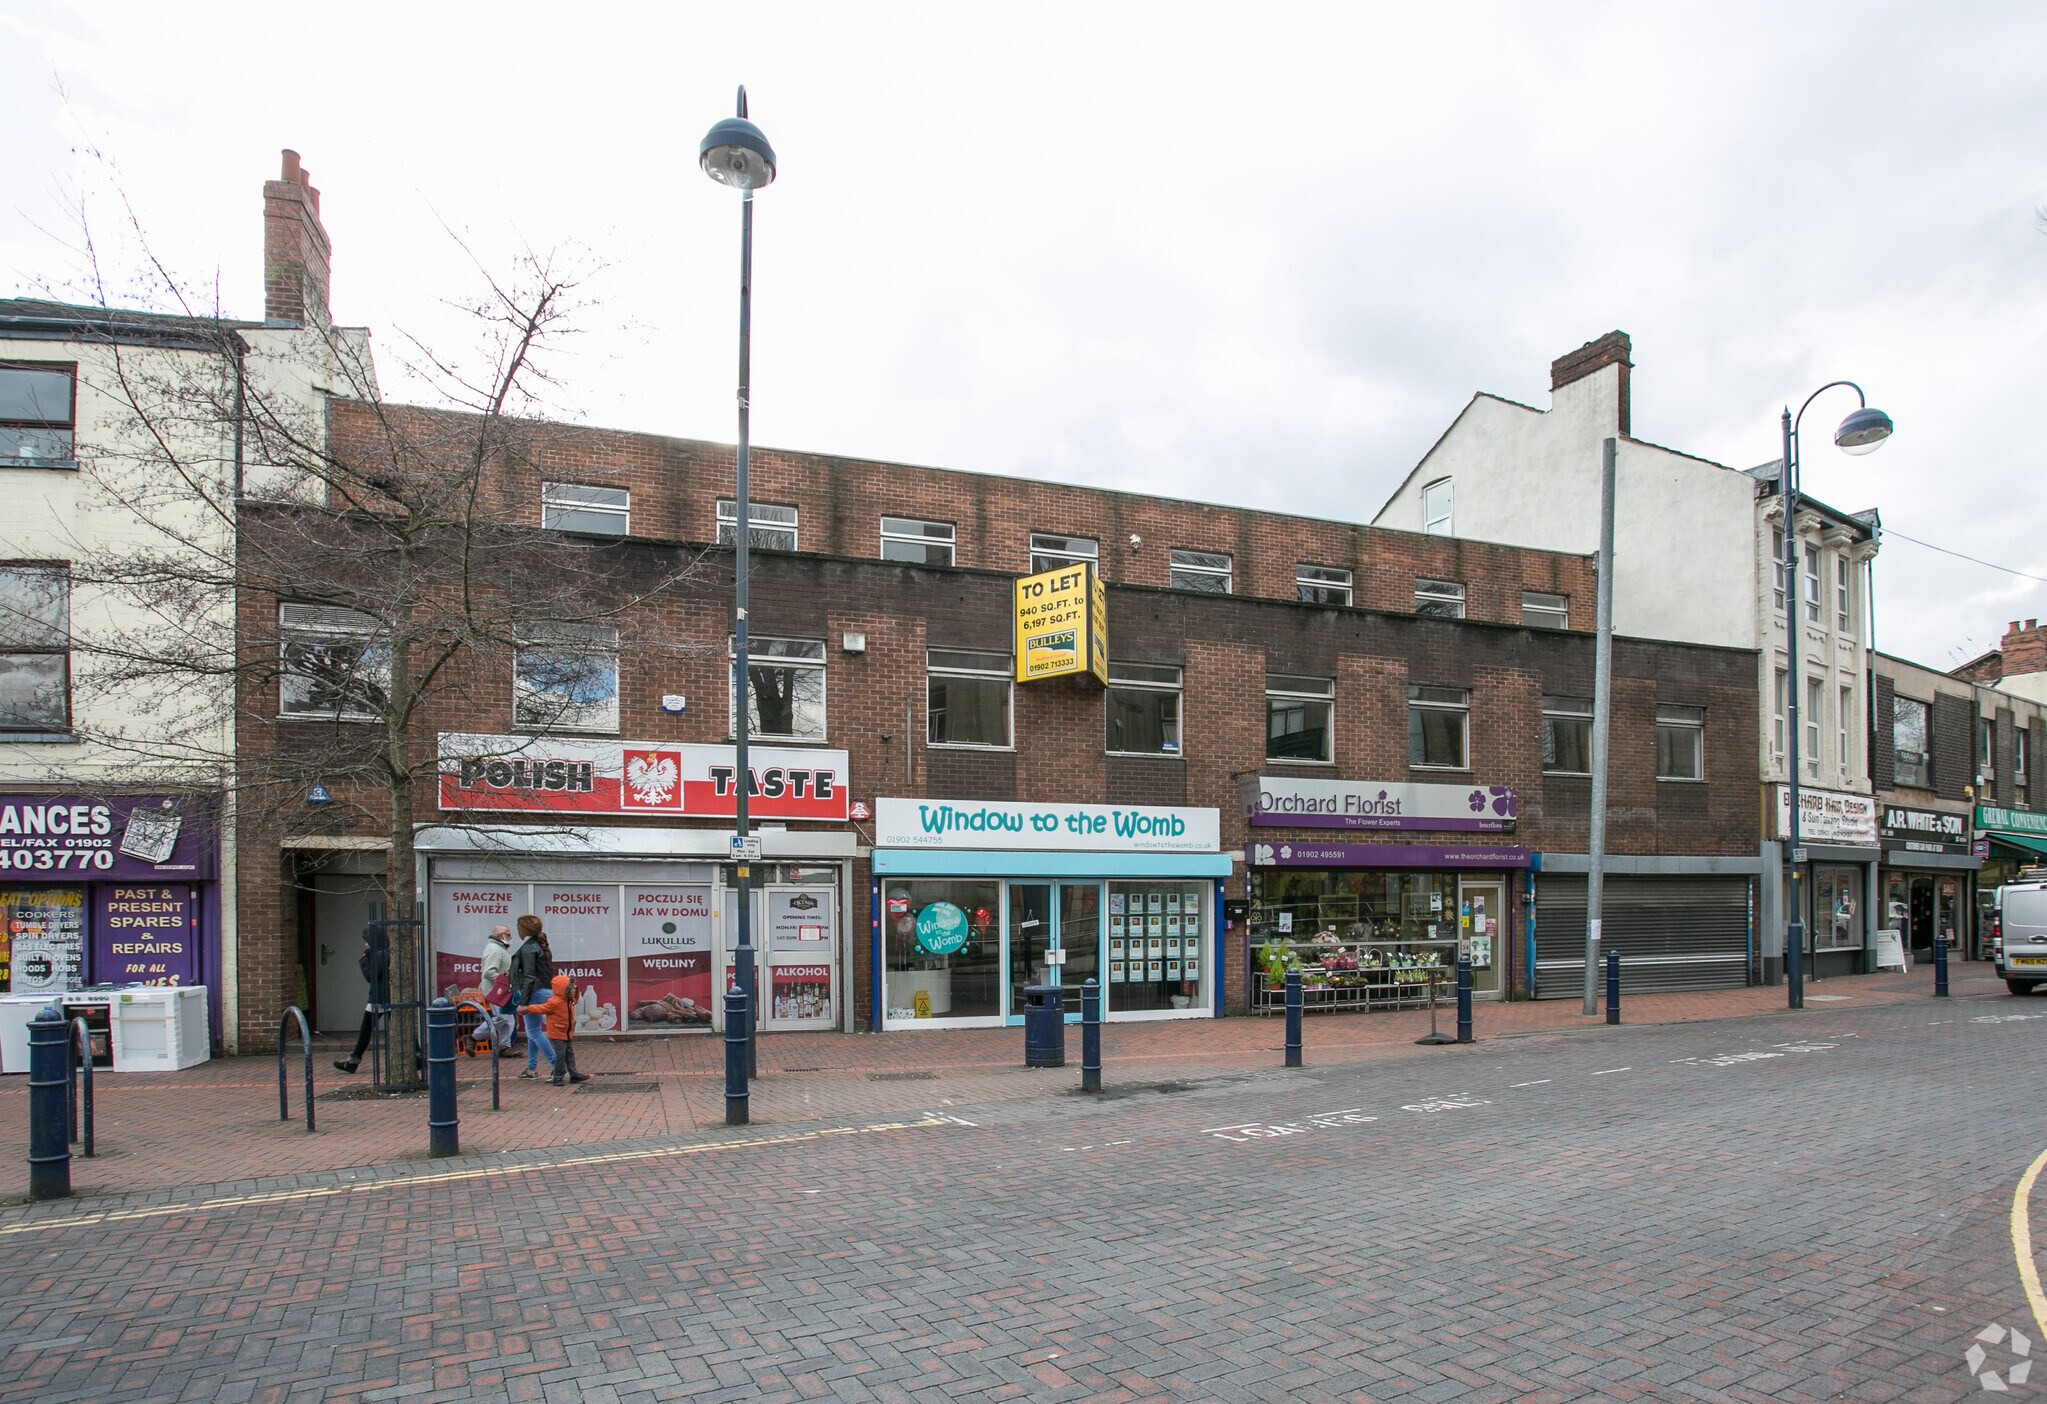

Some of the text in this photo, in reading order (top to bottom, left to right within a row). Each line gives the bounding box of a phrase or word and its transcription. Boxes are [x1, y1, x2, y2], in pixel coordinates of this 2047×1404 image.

[1022, 582, 1044, 599] TO
[1050, 572, 1082, 593] LET
[1020, 597, 1084, 617] 940 SQ.FT. to
[1023, 611, 1080, 630] 6,197 SQ.FT.
[1029, 632, 1074, 649] BULLEYS
[1029, 658, 1074, 672] 01902 713333
[459, 757, 594, 792] POLISH
[709, 765, 835, 799] TASTE
[1260, 790, 1402, 815] Orchard Florist
[0, 805, 112, 835] ANCES
[918, 805, 1185, 838] Window to the Womb
[1357, 818, 1377, 826] Flower
[1378, 819, 1401, 827] Experts
[1907, 811, 1937, 832] WHITE
[1942, 815, 1963, 834] SON
[65, 839, 112, 847] 01902
[887, 836, 943, 844] 01902 544755
[0, 849, 114, 870] 403770
[28, 893, 82, 907] OPTIONS
[115, 889, 173, 900] PAST &
[453, 892, 513, 903] SMACZNE
[553, 893, 602, 903] POLSKIE
[638, 894, 703, 906] POCZUJ SIĘ
[108, 902, 184, 912] PRESENT
[457, 903, 509, 915] I ŚWIEŻE
[544, 905, 610, 915] PRODUKTY
[631, 907, 709, 917] JAK W DOMU
[16, 911, 76, 919] COOKERS
[15, 921, 80, 929] TUMBLE DRYERS
[110, 916, 183, 928] SPARES
[917, 916, 961, 935] Window
[15, 932, 38, 940] SPIN
[41, 932, 80, 940] DRYERS
[140, 932, 155, 940] &
[641, 937, 696, 946] LUKULLUS
[928, 933, 963, 950] Womb
[15, 943, 33, 951] GAS
[112, 942, 183, 954] REPAIRS
[125, 963, 166, 973] FOR ALL
[643, 959, 696, 970] WĘDLINY
[558, 967, 604, 978] NABIAŁ
[776, 967, 829, 976] ALKOHOL
[16, 976, 44, 984] AUTOS
